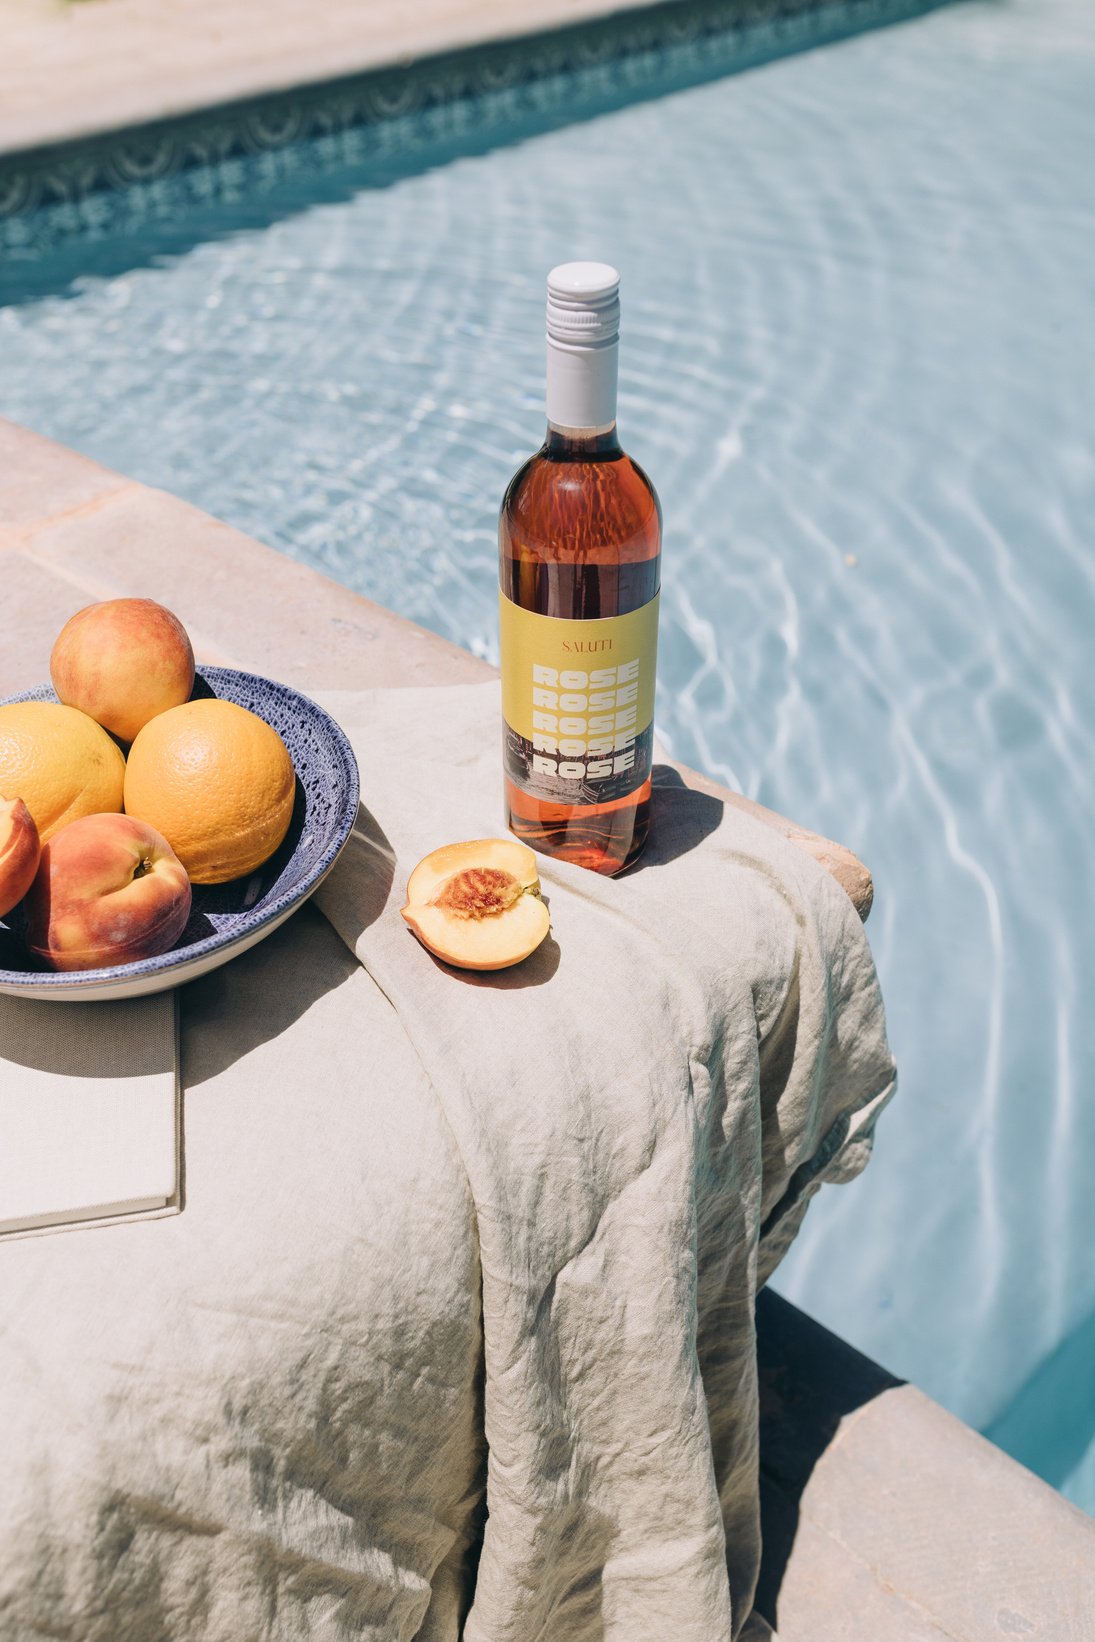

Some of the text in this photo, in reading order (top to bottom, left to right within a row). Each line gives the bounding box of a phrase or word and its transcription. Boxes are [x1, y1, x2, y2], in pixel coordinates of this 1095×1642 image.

[532, 658, 639, 690] ROSE
[532, 681, 639, 713] ROSE
[532, 704, 637, 735] ROSE
[532, 727, 636, 757] ROSE
[532, 750, 635, 779] ROSE
